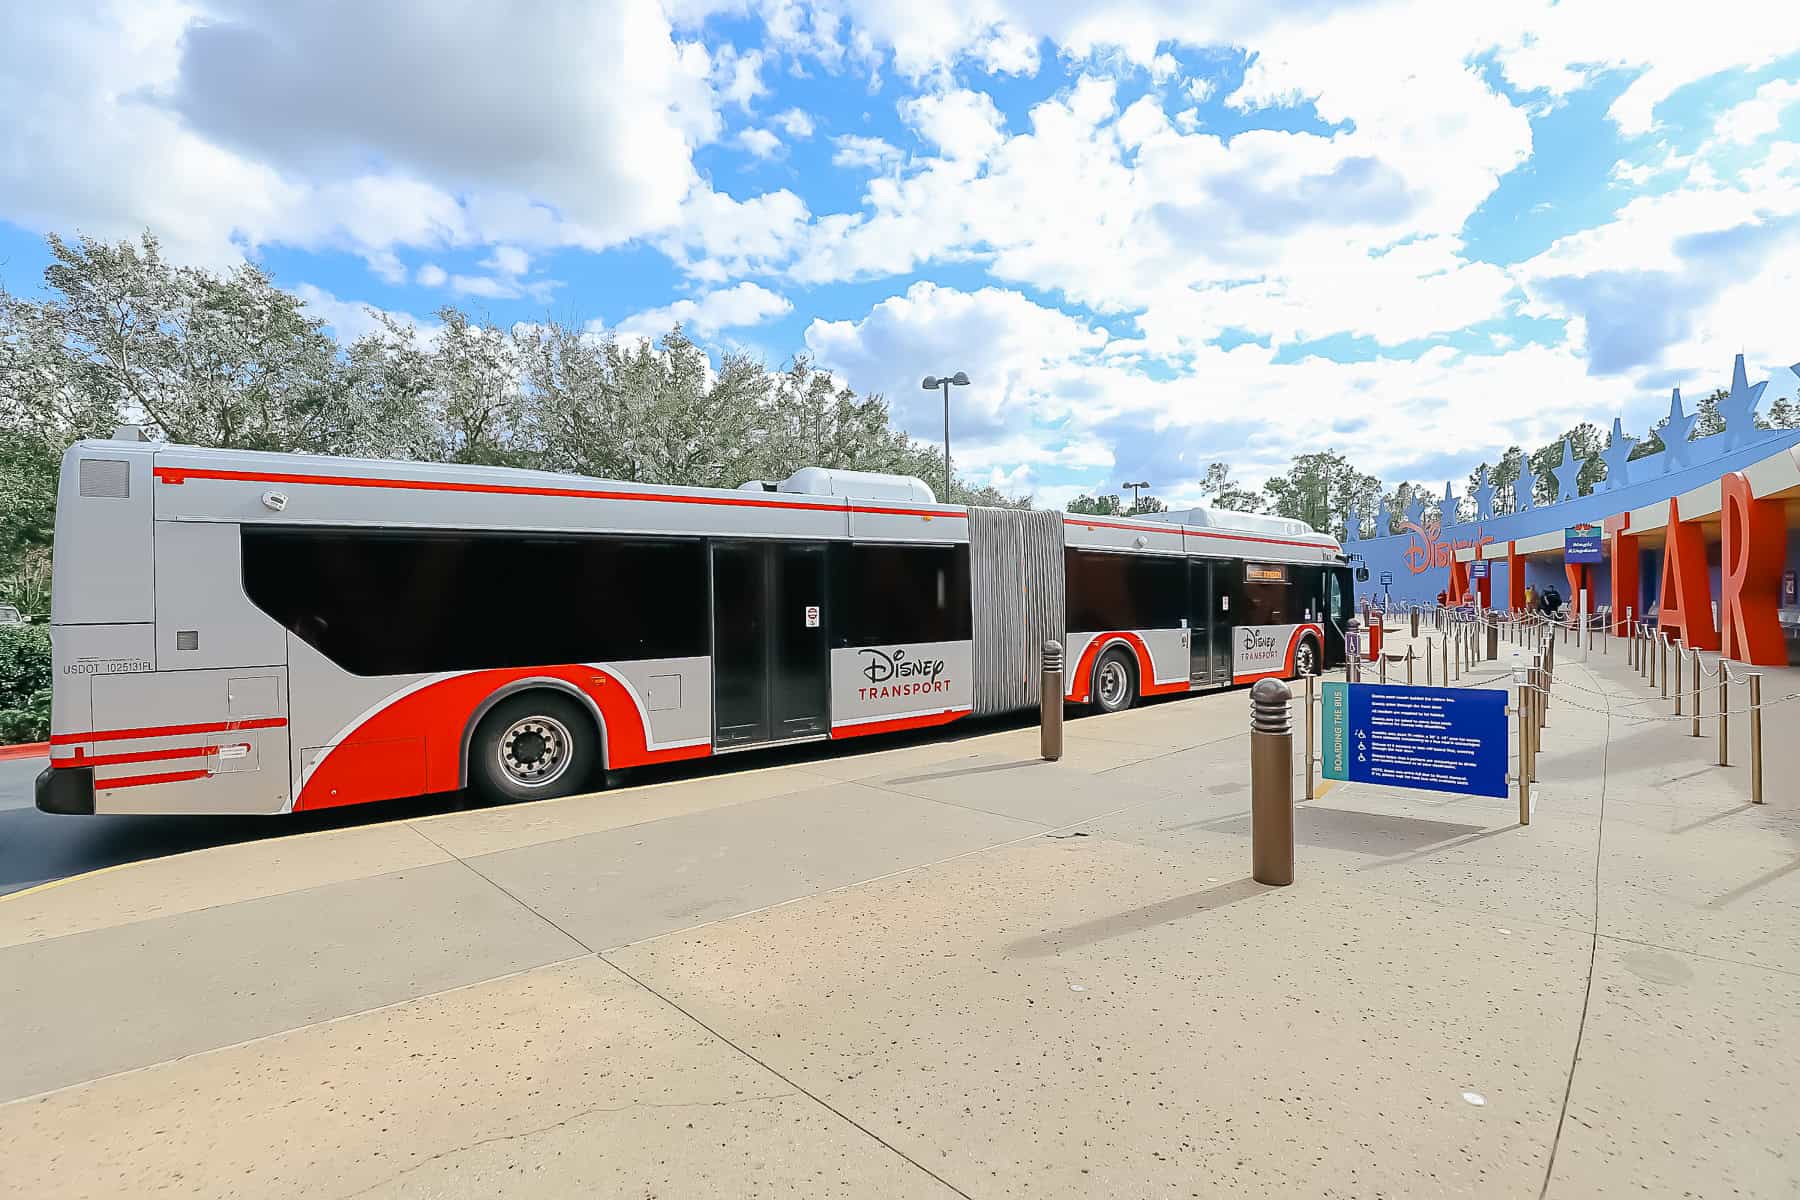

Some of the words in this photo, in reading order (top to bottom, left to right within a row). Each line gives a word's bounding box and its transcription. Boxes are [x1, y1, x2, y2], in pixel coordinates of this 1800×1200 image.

[1241, 627, 1276, 651] Disney
[1240, 650, 1278, 662] TRANSPORT
[63, 663, 99, 675] USDOT
[858, 649, 944, 685] Disney
[858, 680, 951, 701] TRANSPORT
[1333, 690, 1343, 707] BUS
[1333, 708, 1343, 726] THE
[1333, 727, 1343, 772] BOARDING
